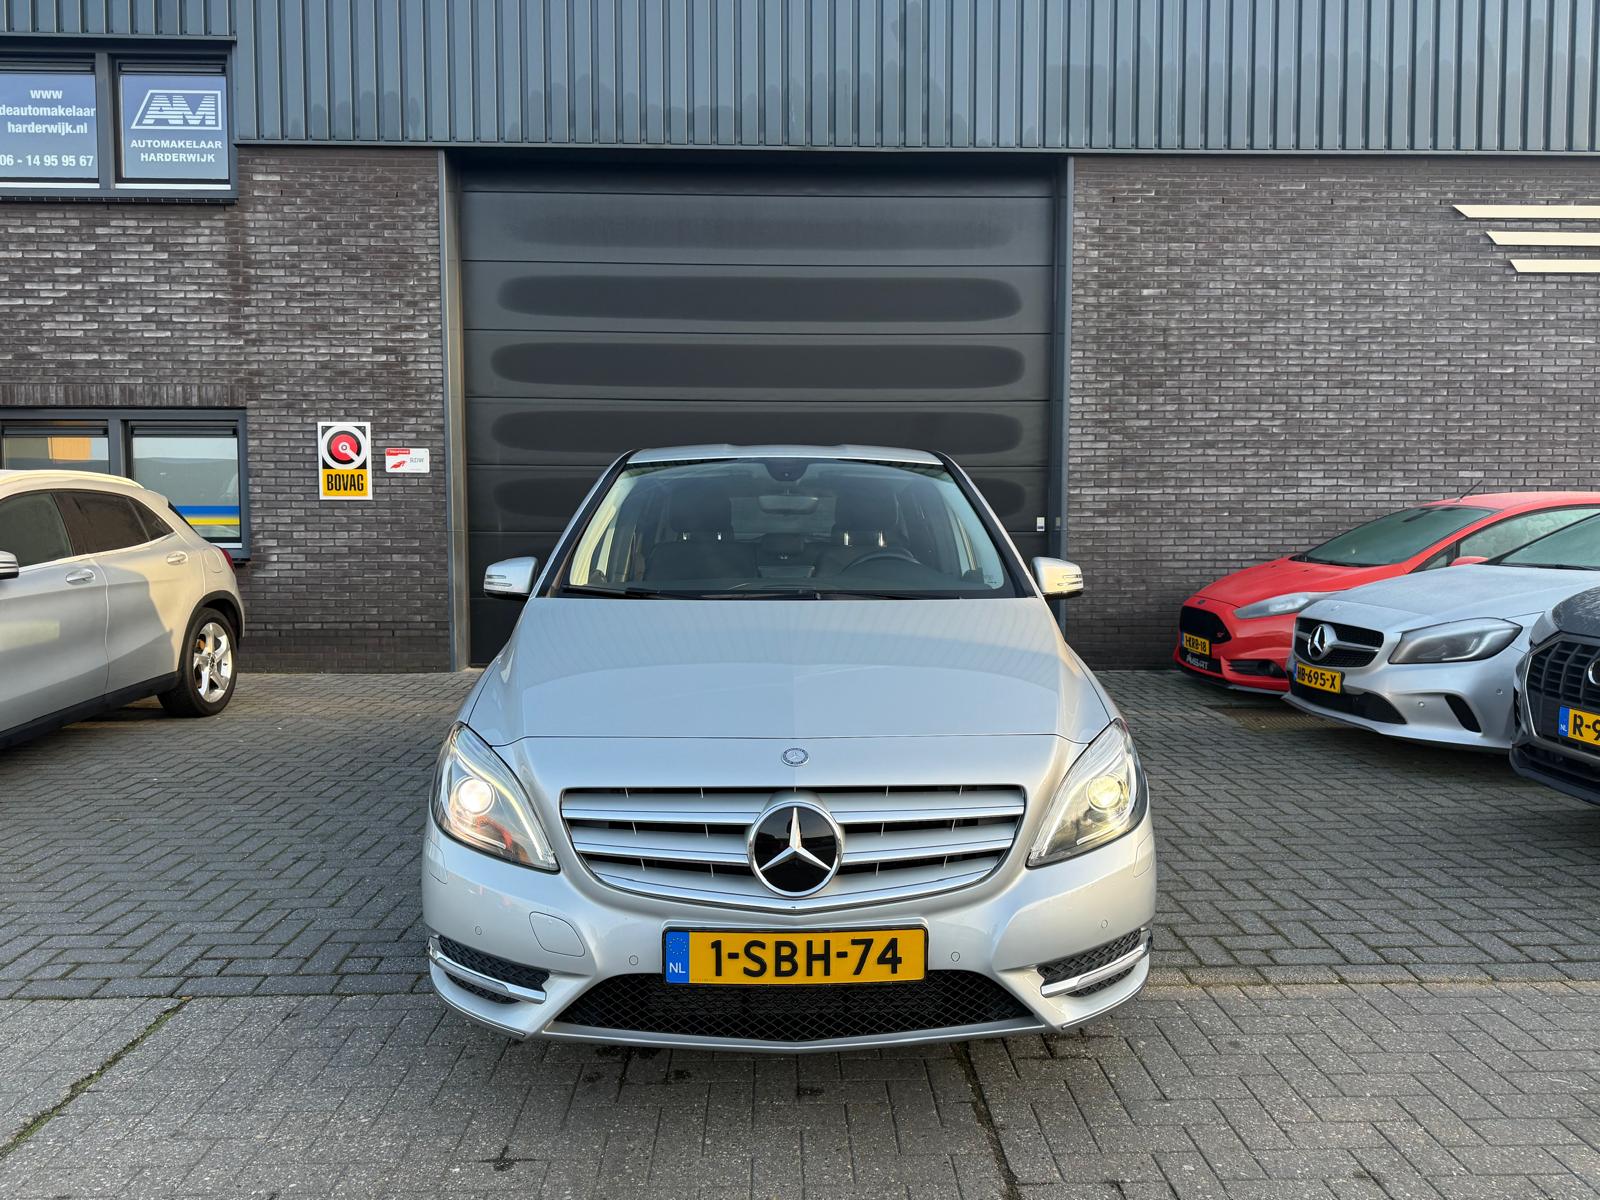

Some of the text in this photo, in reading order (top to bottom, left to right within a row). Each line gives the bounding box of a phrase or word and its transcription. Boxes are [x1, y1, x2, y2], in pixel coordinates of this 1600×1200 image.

[30, 89, 63, 99] www
[0, 104, 96, 117] deautomakelaar
[7, 121, 88, 136] harderwijk.nl
[130, 139, 222, 149] AUTOMAKELAAR
[0, 154, 14, 166] 06
[25, 154, 41, 167] 14
[43, 154, 59, 167] 95
[61, 154, 77, 167] 95
[79, 154, 94, 167] 67
[140, 152, 216, 163] HARDERWIJK
[326, 473, 364, 491] BOVAG
[710, 937, 903, 978] 1-SBH-74
[669, 962, 686, 974] NL
